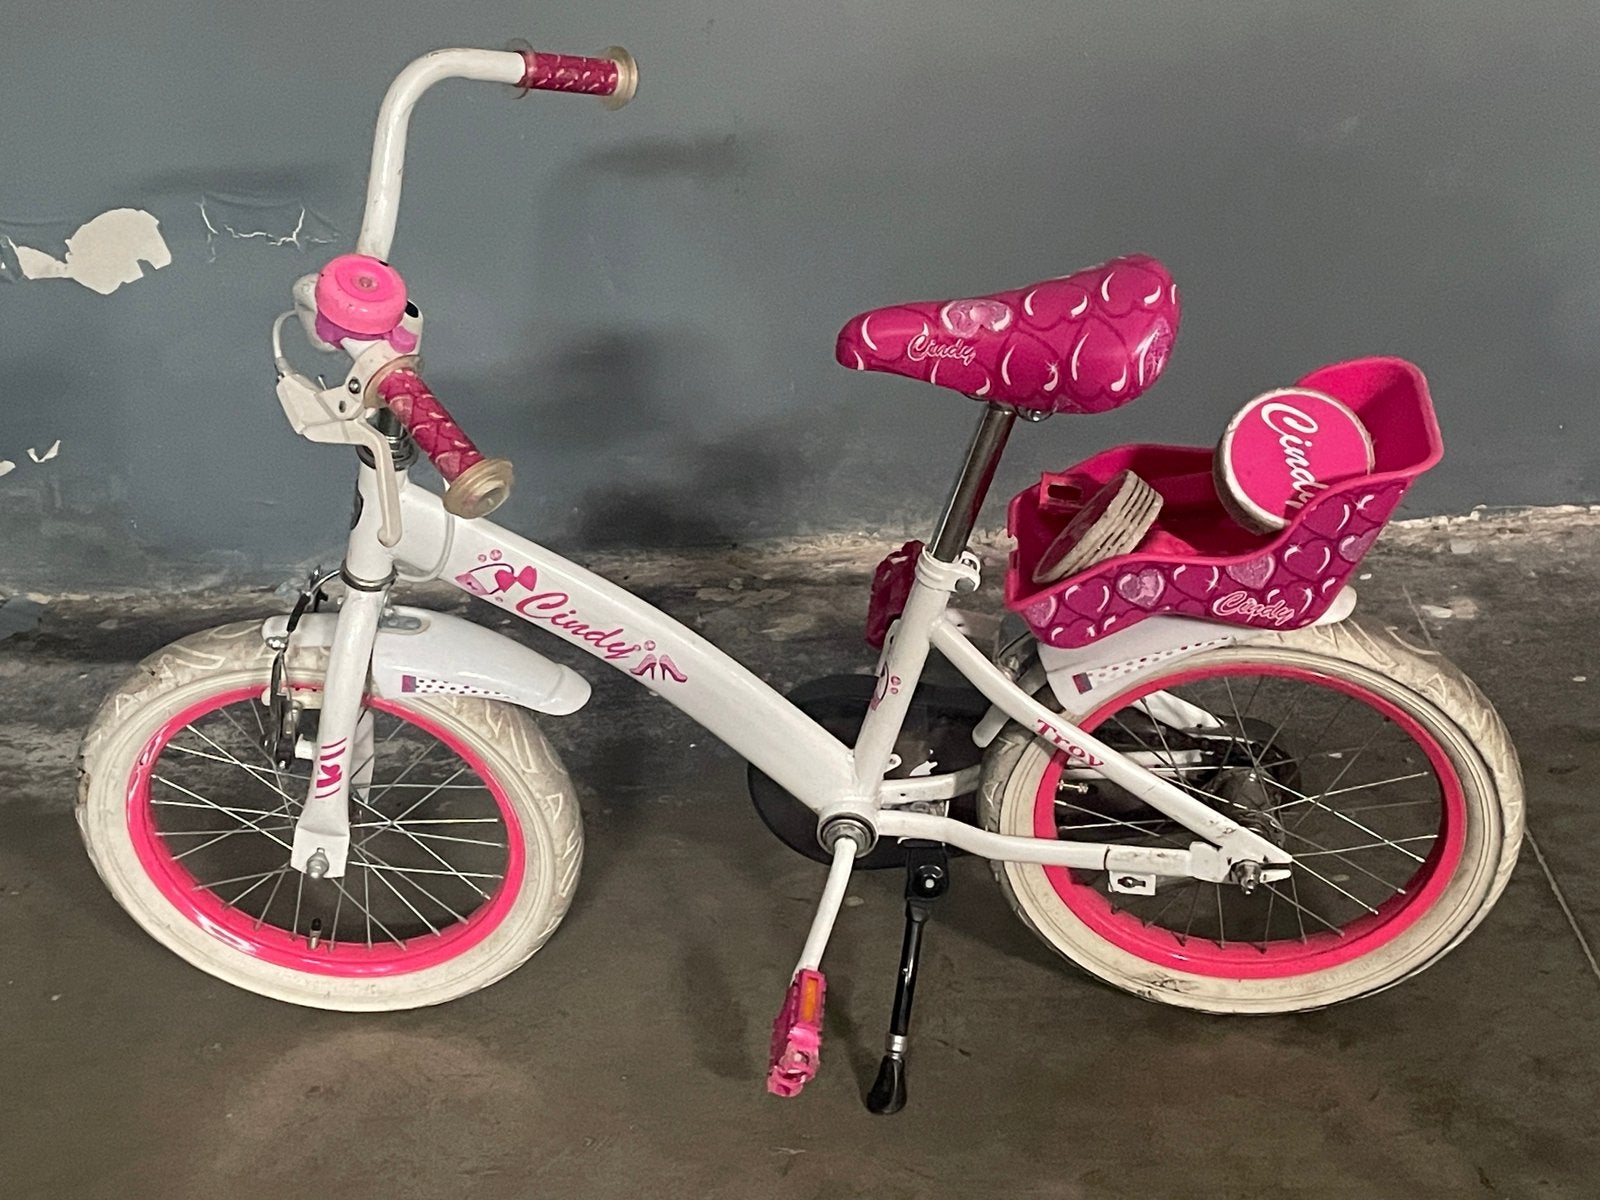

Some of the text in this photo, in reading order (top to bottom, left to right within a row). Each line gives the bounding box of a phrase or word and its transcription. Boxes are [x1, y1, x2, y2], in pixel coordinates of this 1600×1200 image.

[907, 333, 977, 367] Cindy
[515, 592, 639, 659] Cindy
[1212, 591, 1295, 626] Cindy
